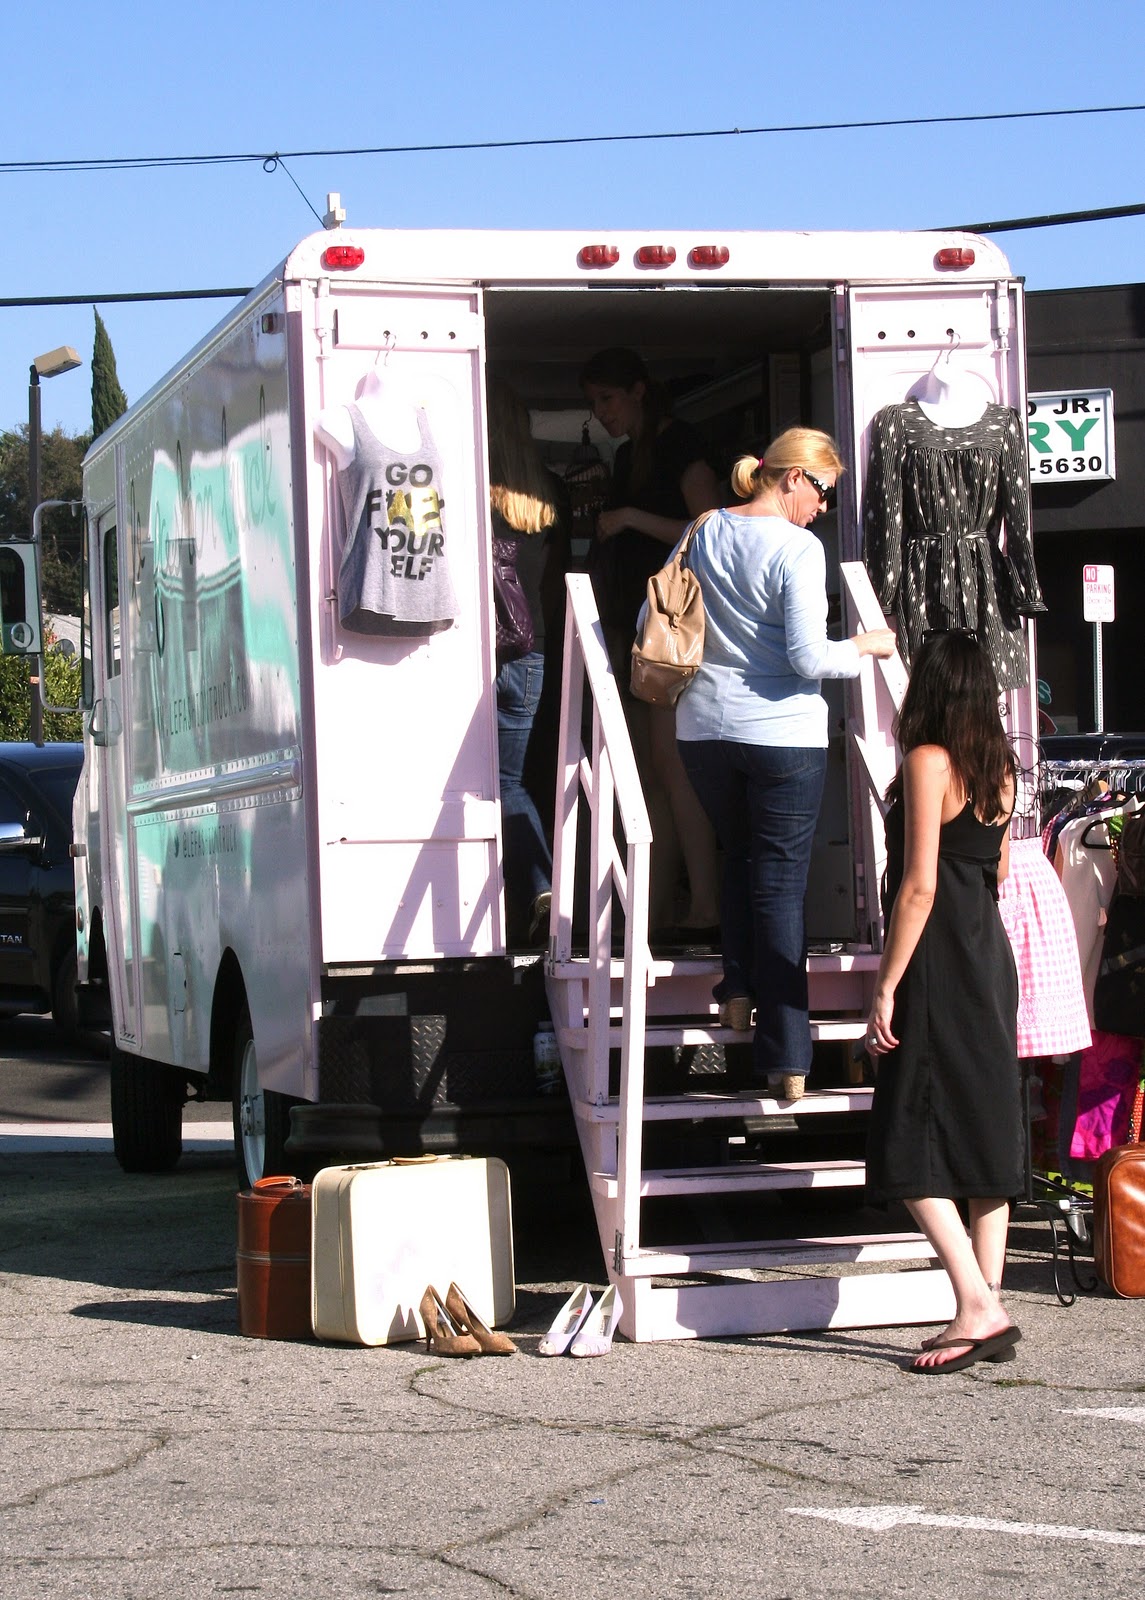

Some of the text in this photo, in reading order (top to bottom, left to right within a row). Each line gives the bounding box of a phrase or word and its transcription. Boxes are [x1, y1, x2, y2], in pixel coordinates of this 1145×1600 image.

[1053, 398, 1101, 415] JR.
[1028, 418, 1100, 454] RY
[385, 462, 433, 488] GO
[1030, 456, 1102, 475] -5630
[374, 527, 445, 557] YOUR
[1086, 567, 1096, 581] NO
[1086, 584, 1112, 594] PARKING
[182, 824, 238, 858] @LEFASIONTRUCK
[0, 935, 23, 944] TAN
